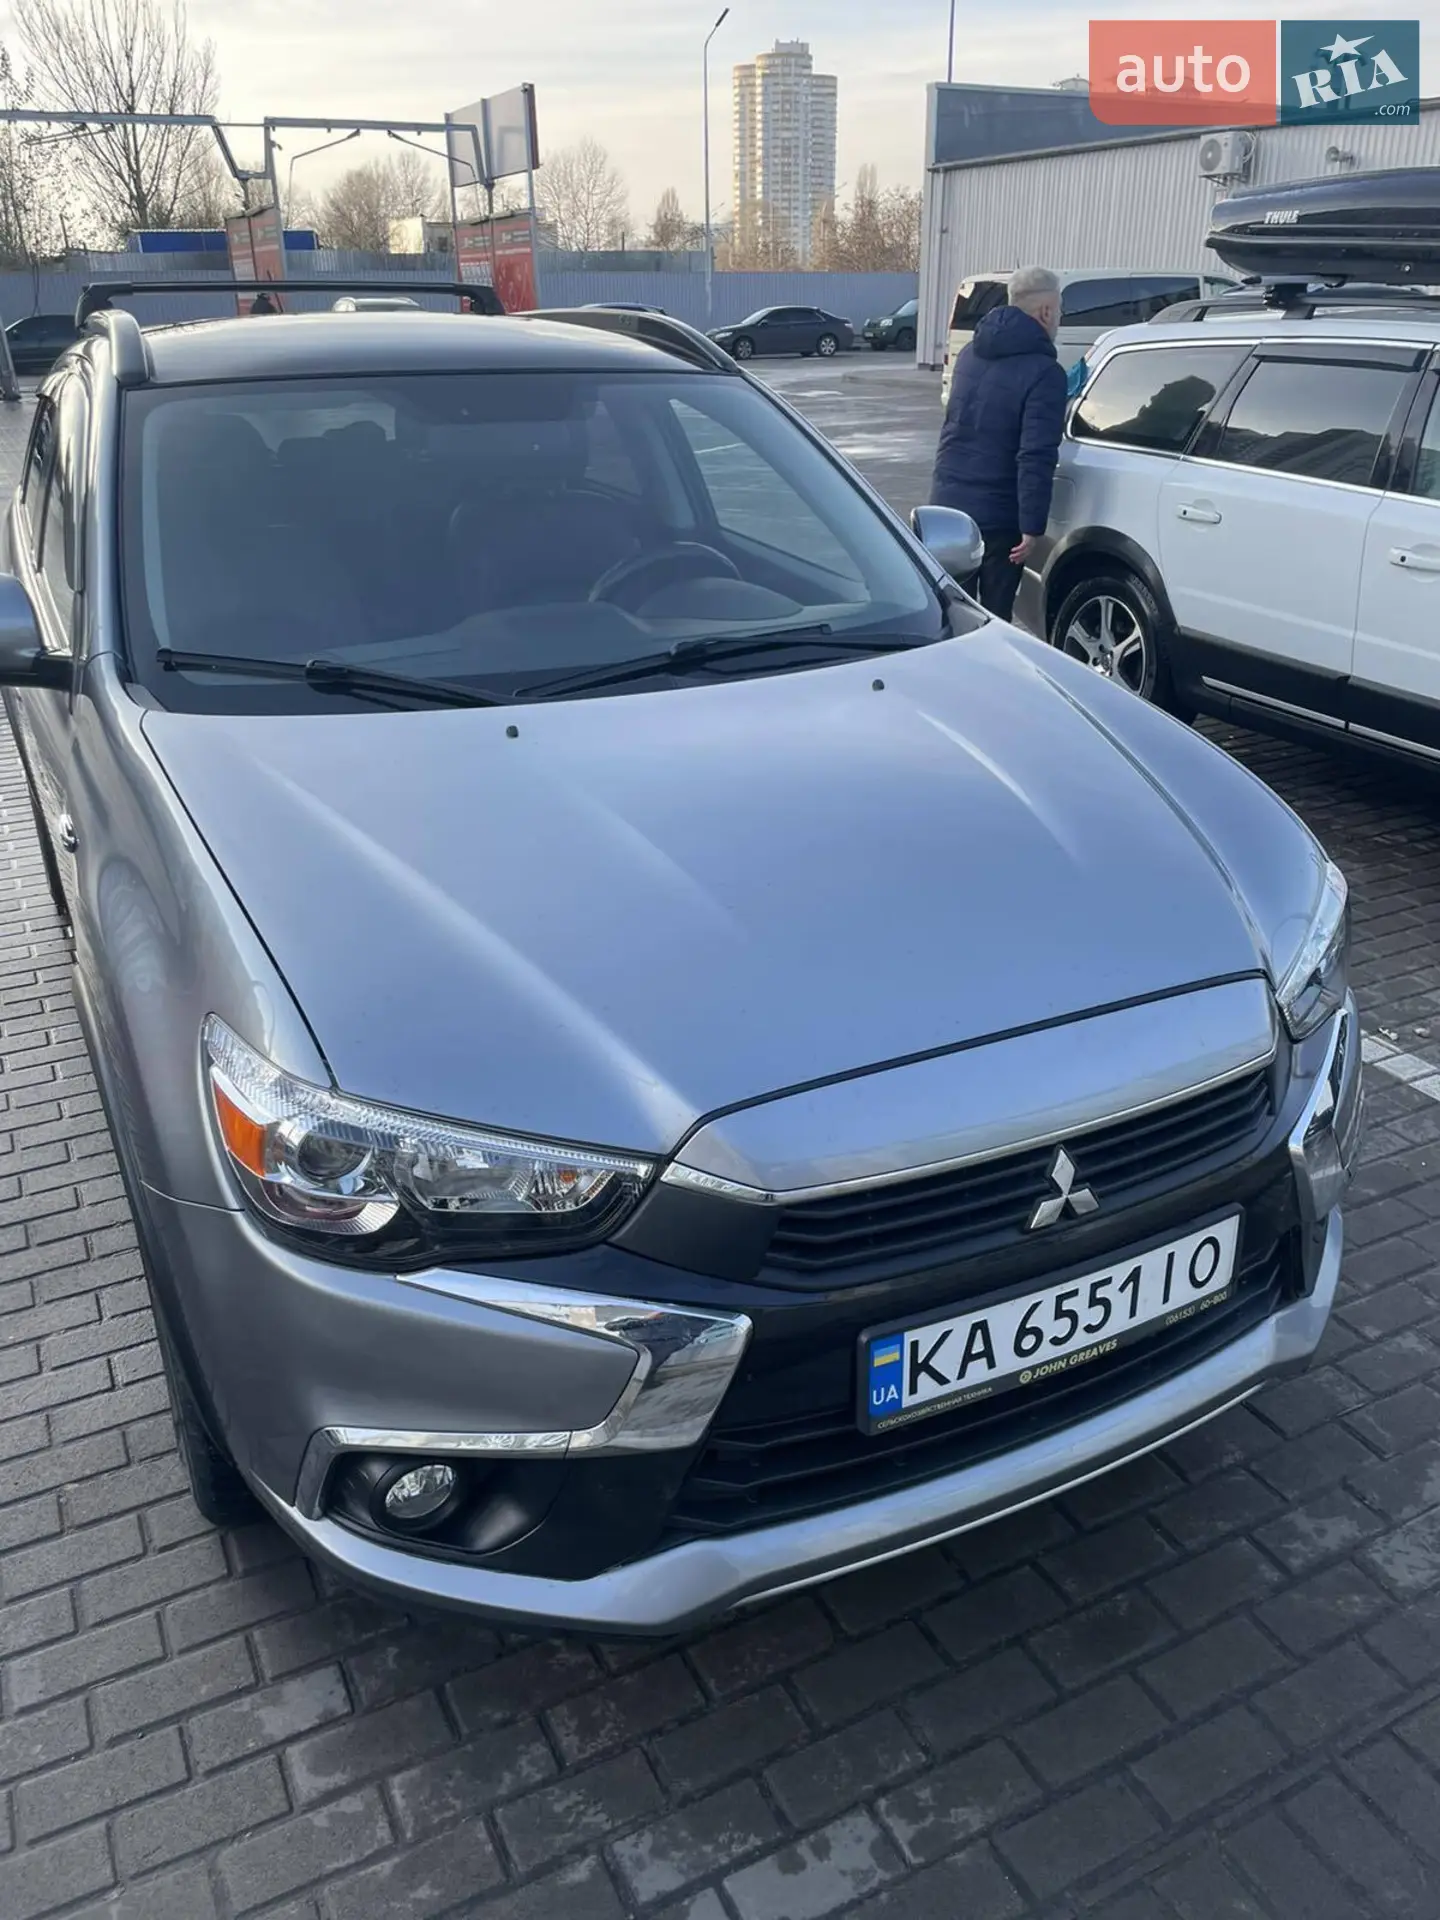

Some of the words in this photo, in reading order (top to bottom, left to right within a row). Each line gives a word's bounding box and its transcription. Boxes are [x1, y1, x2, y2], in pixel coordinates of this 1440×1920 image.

[1264, 210, 1300, 225] THULE
[908, 1318, 997, 1397] KA
[1013, 1264, 1142, 1359] 6551
[1161, 1235, 1221, 1305] IO
[1033, 1358, 1067, 1379] JOHN
[1069, 1339, 1118, 1365] GREAVES
[872, 1384, 899, 1406] UA
